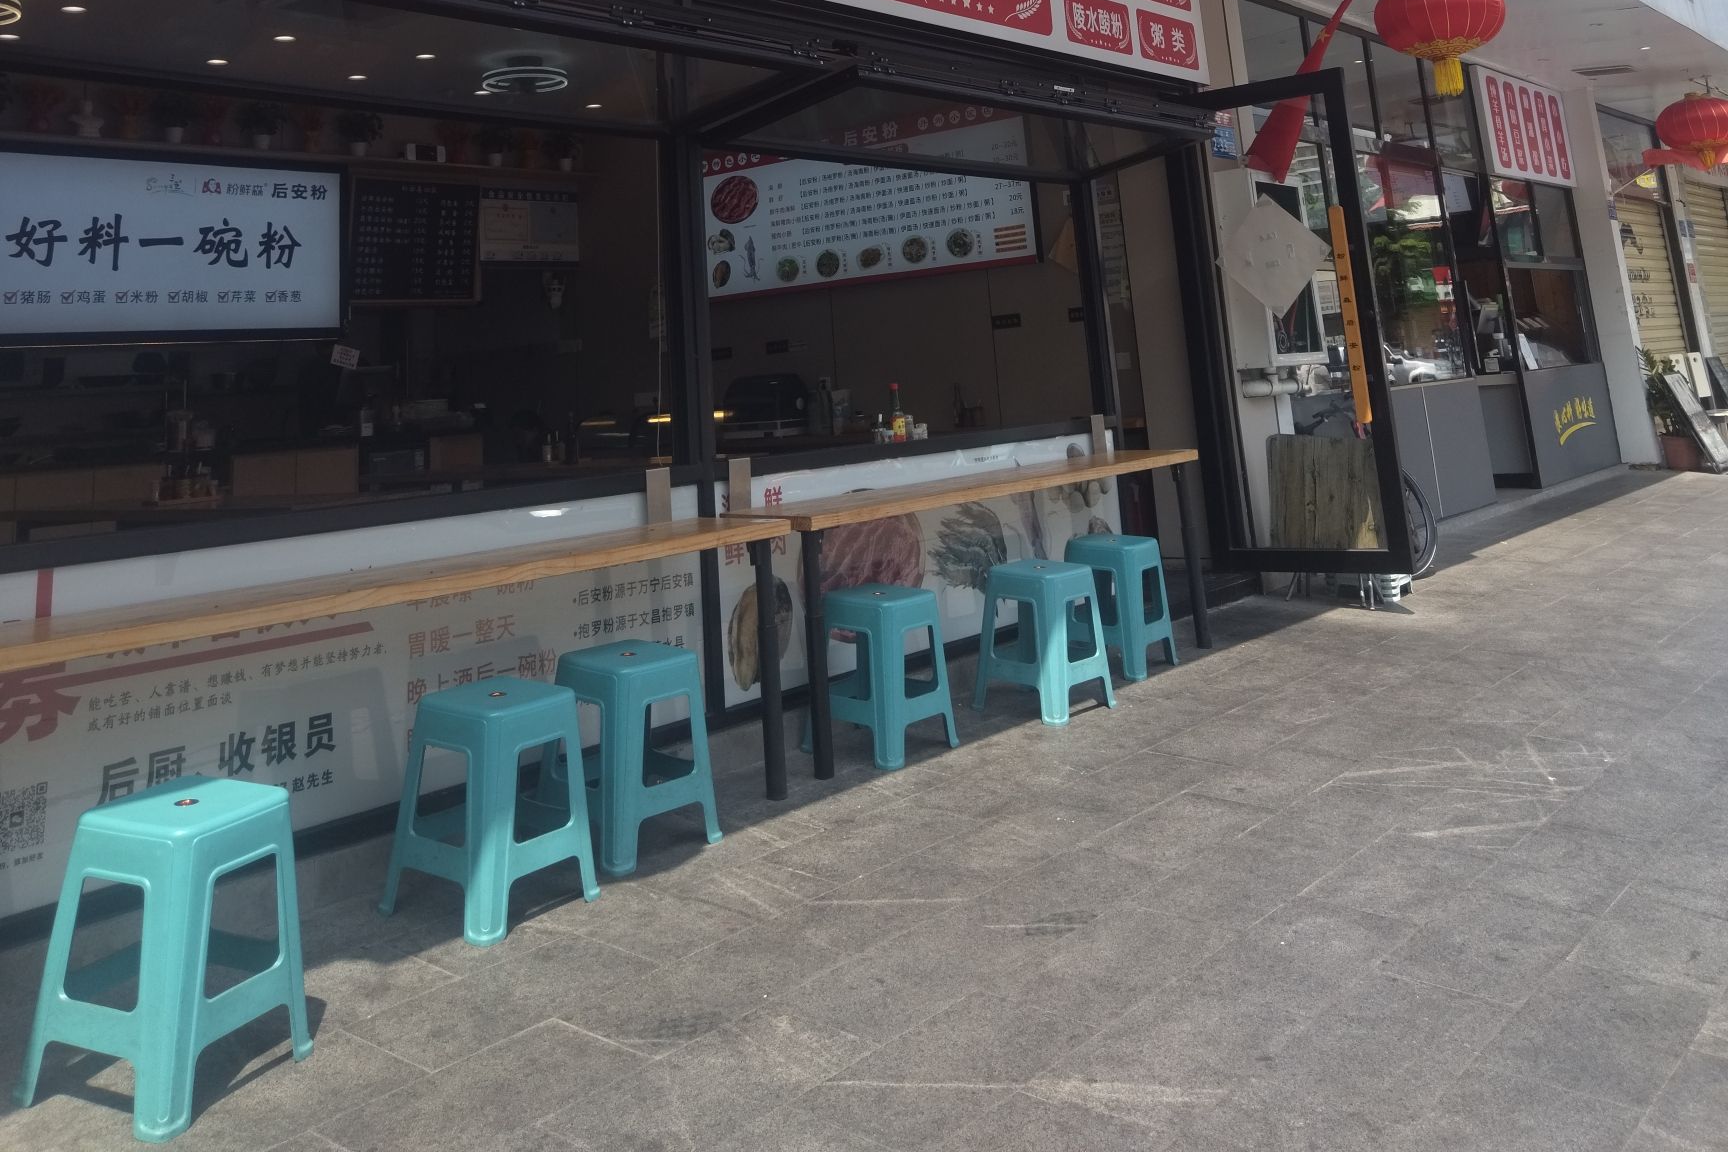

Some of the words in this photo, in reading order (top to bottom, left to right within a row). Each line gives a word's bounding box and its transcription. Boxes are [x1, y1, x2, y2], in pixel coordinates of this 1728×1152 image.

[1072, 2, 1123, 40] 陵水酸粉
[1150, 22, 1186, 54] 粥类
[844, 121, 898, 146] 后安粉
[271, 183, 328, 200] 后安粉
[5, 213, 302, 271] 好料一碗粉
[20, 290, 51, 304] 猪肠
[77, 290, 107, 304] 鸡蛋
[130, 290, 159, 304] 米粉
[182, 290, 209, 304] 胡椒
[230, 290, 256, 304] 芹菜
[278, 290, 303, 304] 香葱
[725, 535, 786, 565] 鲜肉
[408, 614, 516, 659] 胃暖一整天
[87, 692, 233, 733] 或有好的铺面位置面谈
[292, 768, 334, 794] 赵先生
